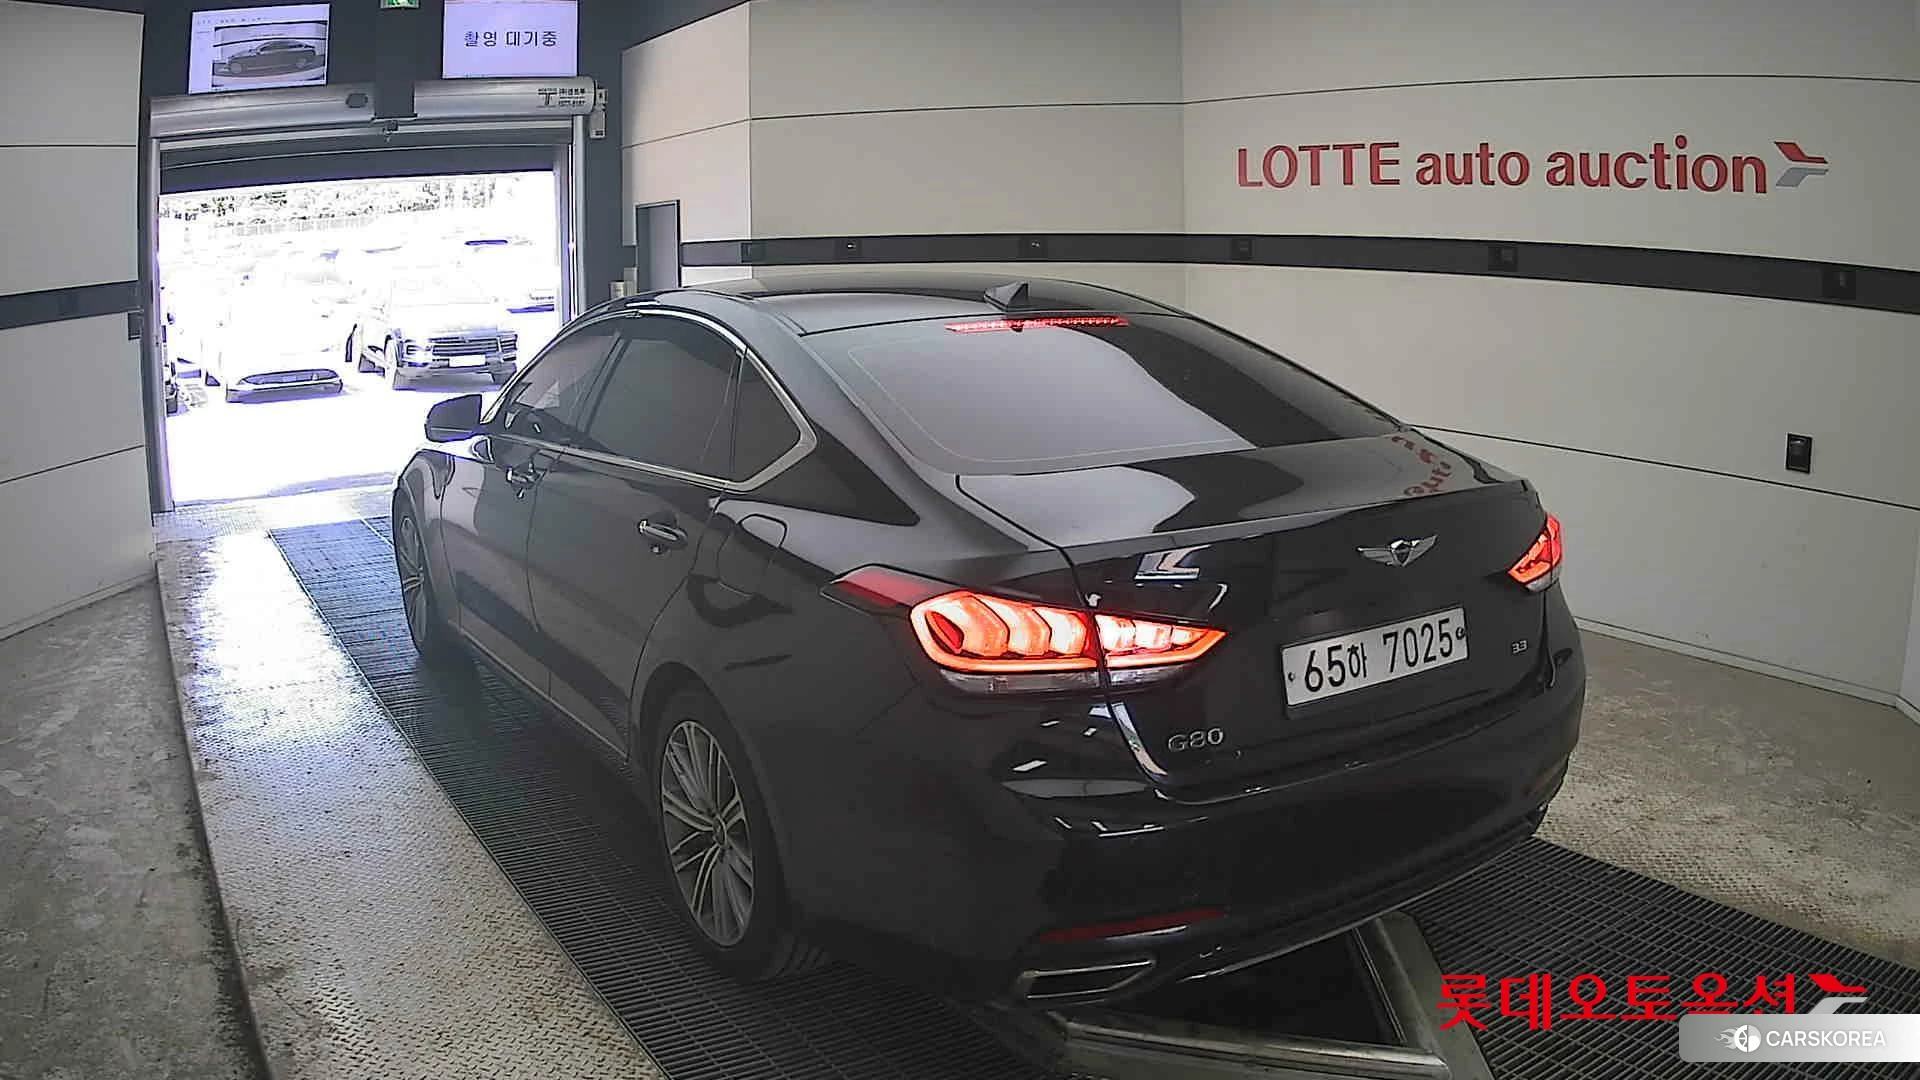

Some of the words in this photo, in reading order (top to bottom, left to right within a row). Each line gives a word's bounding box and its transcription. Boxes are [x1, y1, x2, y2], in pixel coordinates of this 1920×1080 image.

[505, 31, 557, 47] 대기중
[1236, 141, 1400, 188] LOTTE
[1416, 142, 1530, 186] auto
[1545, 135, 1767, 194] auction
[1304, 642, 1367, 692] 65하
[1382, 618, 1453, 673] 7025
[1168, 728, 1223, 751] G80
